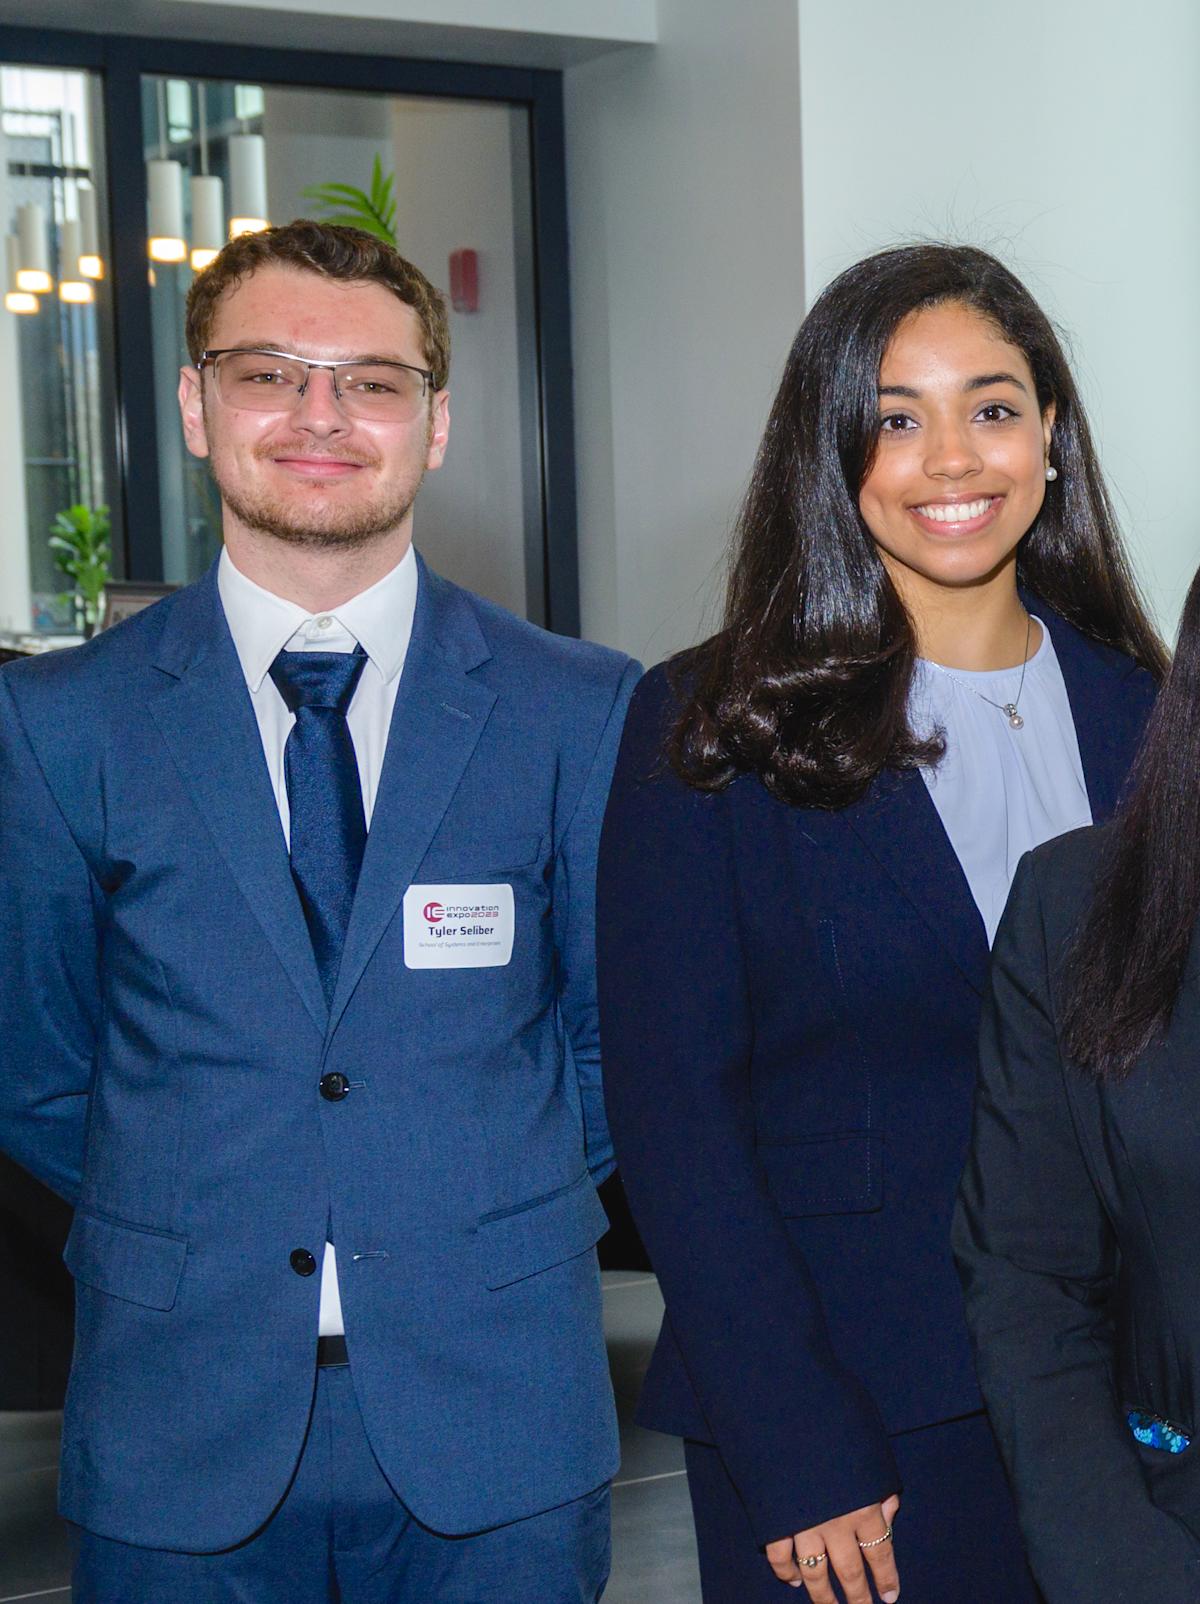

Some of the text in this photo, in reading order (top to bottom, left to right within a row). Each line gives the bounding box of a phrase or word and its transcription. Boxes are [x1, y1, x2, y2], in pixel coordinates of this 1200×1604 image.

[446, 911, 499, 919] expo2023
[428, 925, 494, 938] Tyler Seliber
